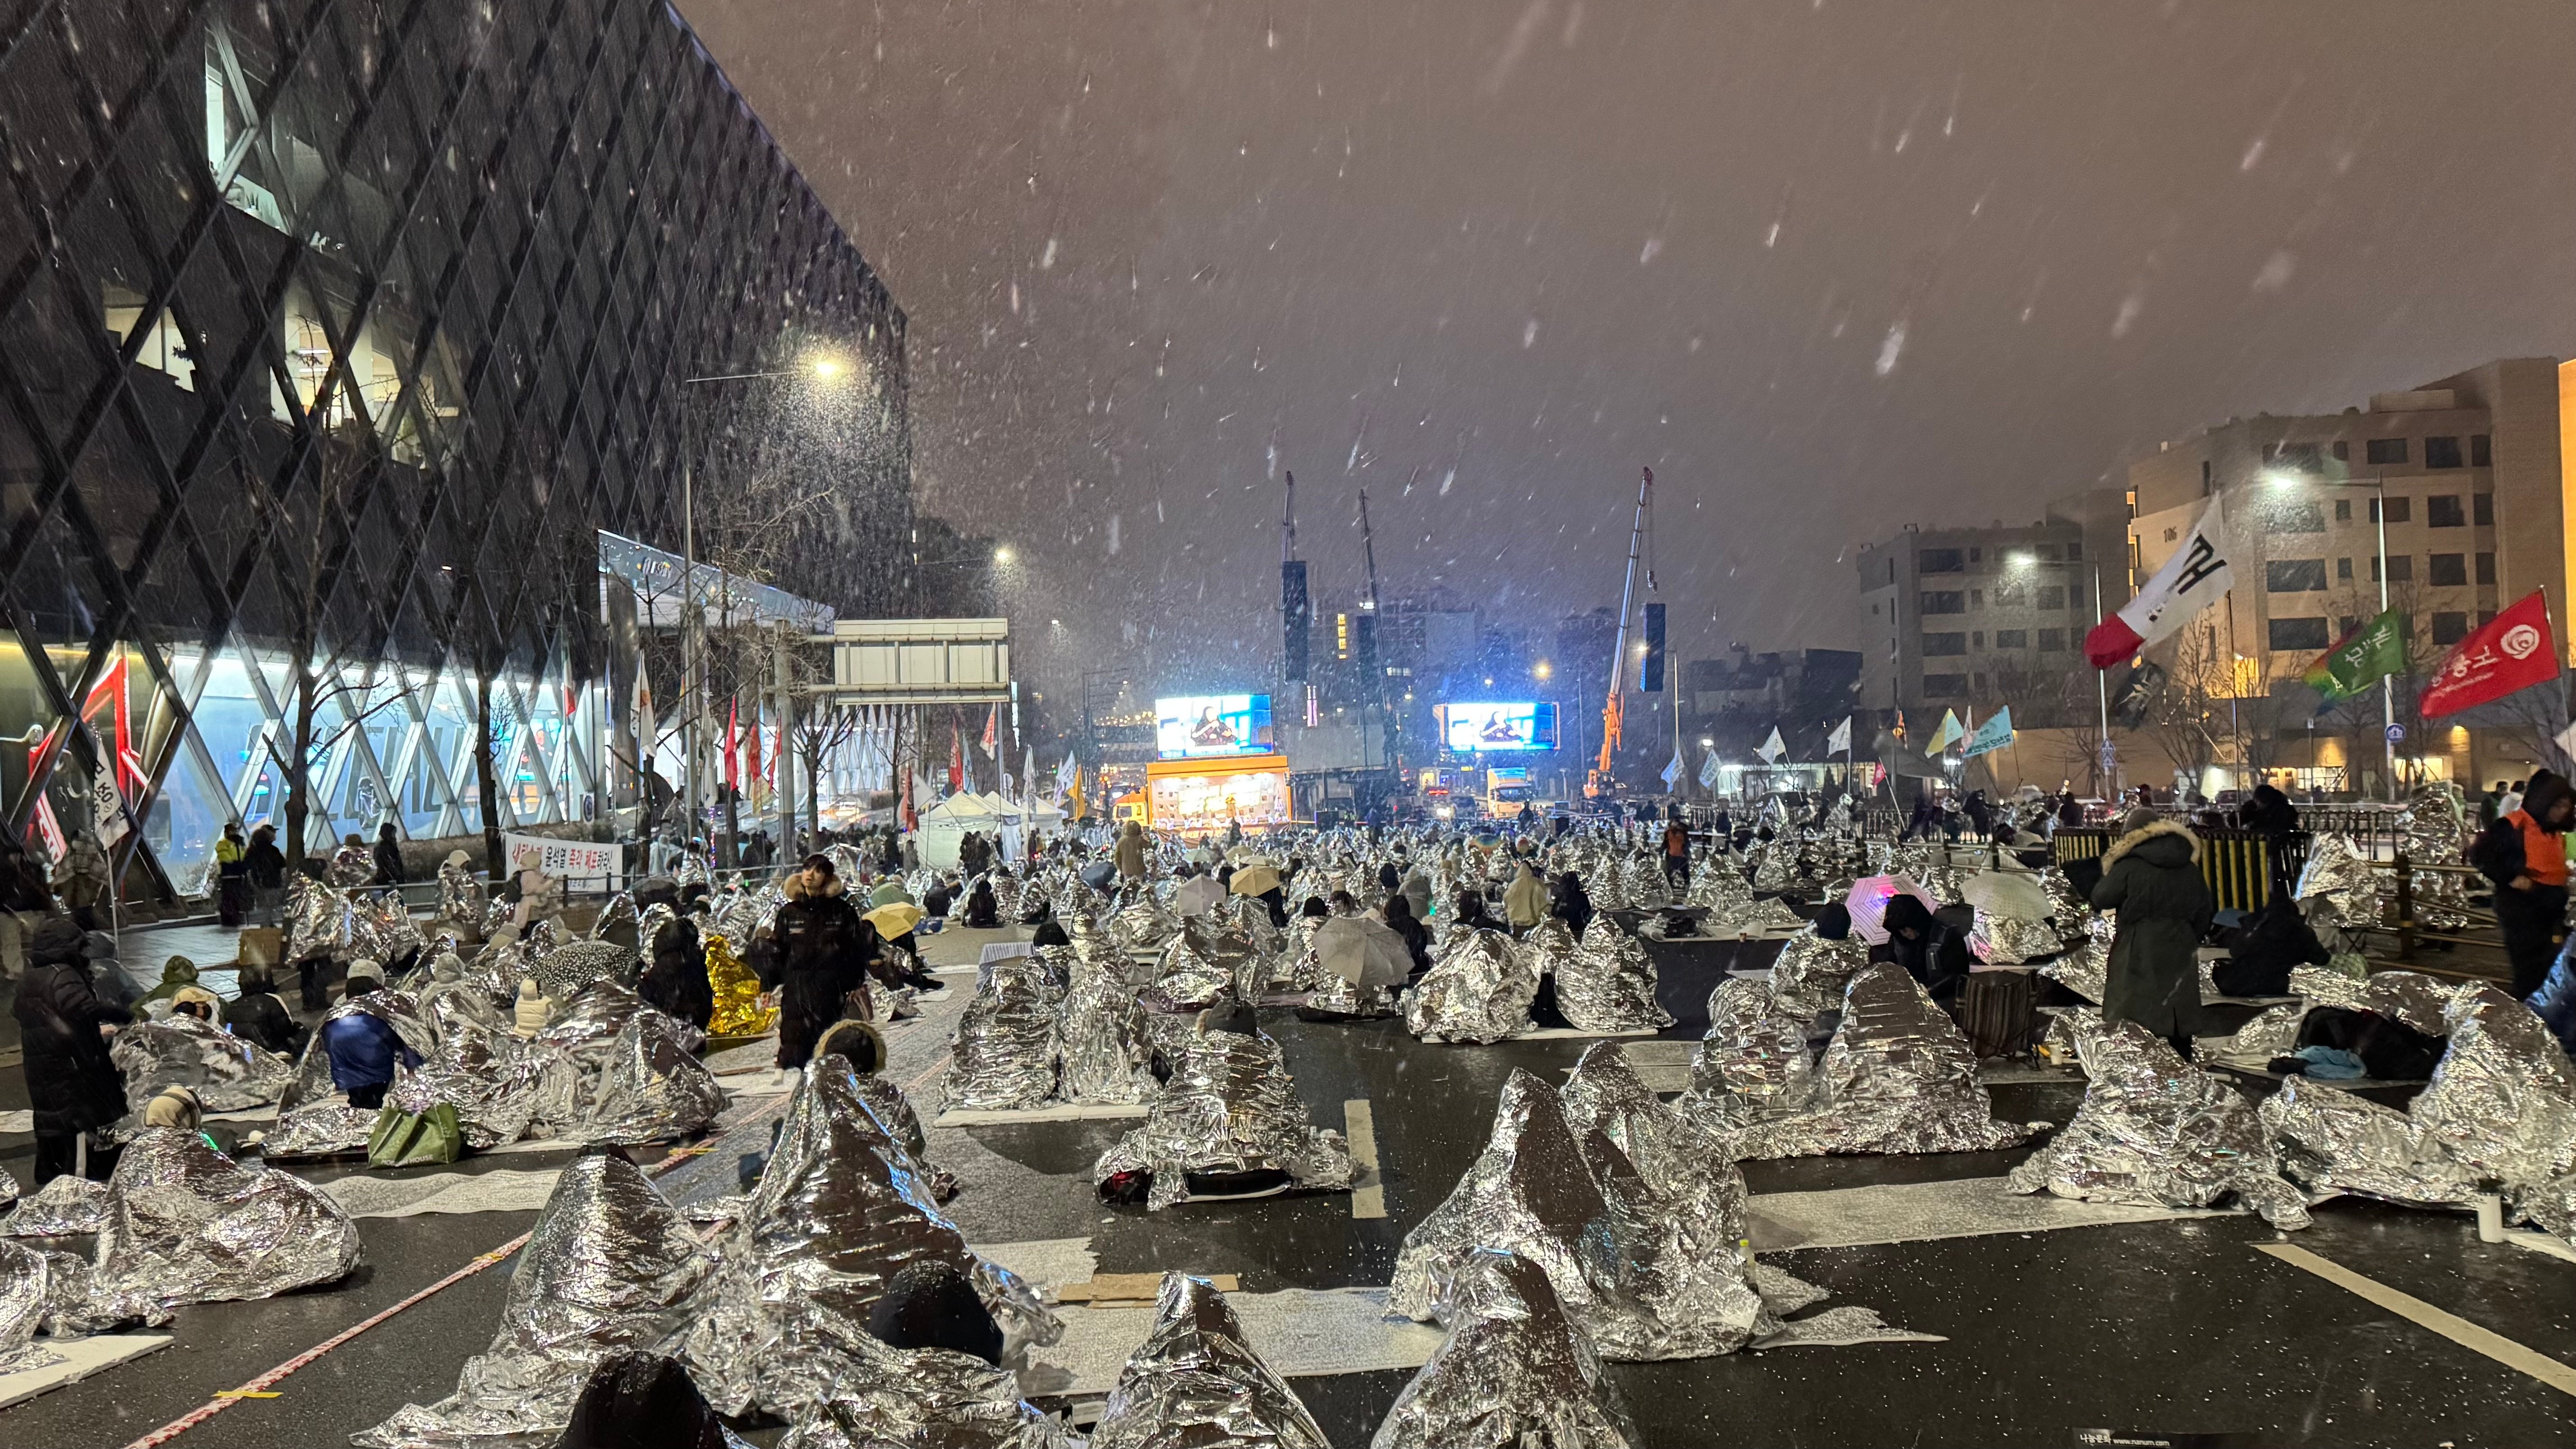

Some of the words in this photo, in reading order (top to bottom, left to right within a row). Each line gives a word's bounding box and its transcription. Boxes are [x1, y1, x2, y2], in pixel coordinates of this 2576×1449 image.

[546, 846, 566, 868] 윤석열
[569, 848, 583, 869] 즉각
[409, 1154, 433, 1164] HOUSE
